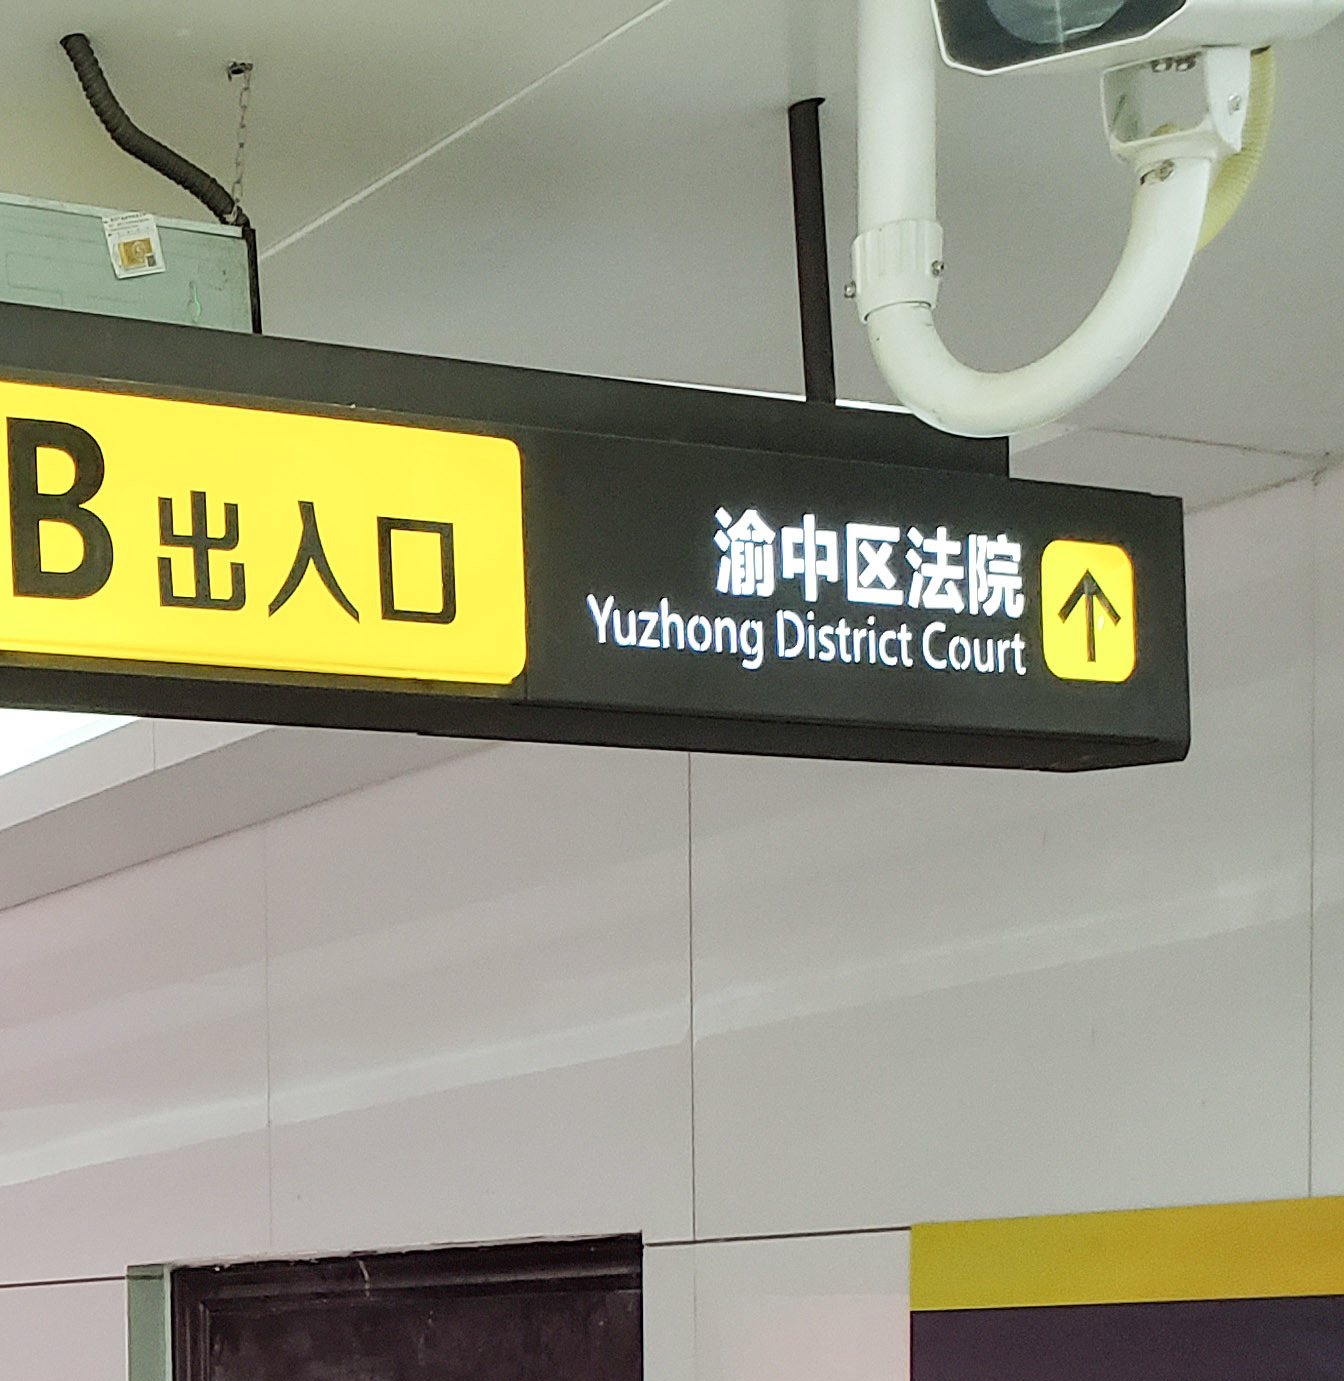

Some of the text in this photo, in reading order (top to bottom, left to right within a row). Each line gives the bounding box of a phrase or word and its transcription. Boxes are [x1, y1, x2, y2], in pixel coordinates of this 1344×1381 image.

[6, 416, 456, 624] B 出入口
[713, 507, 1025, 618] 渝中区法院
[586, 594, 1027, 675] Yuzhong District Court
